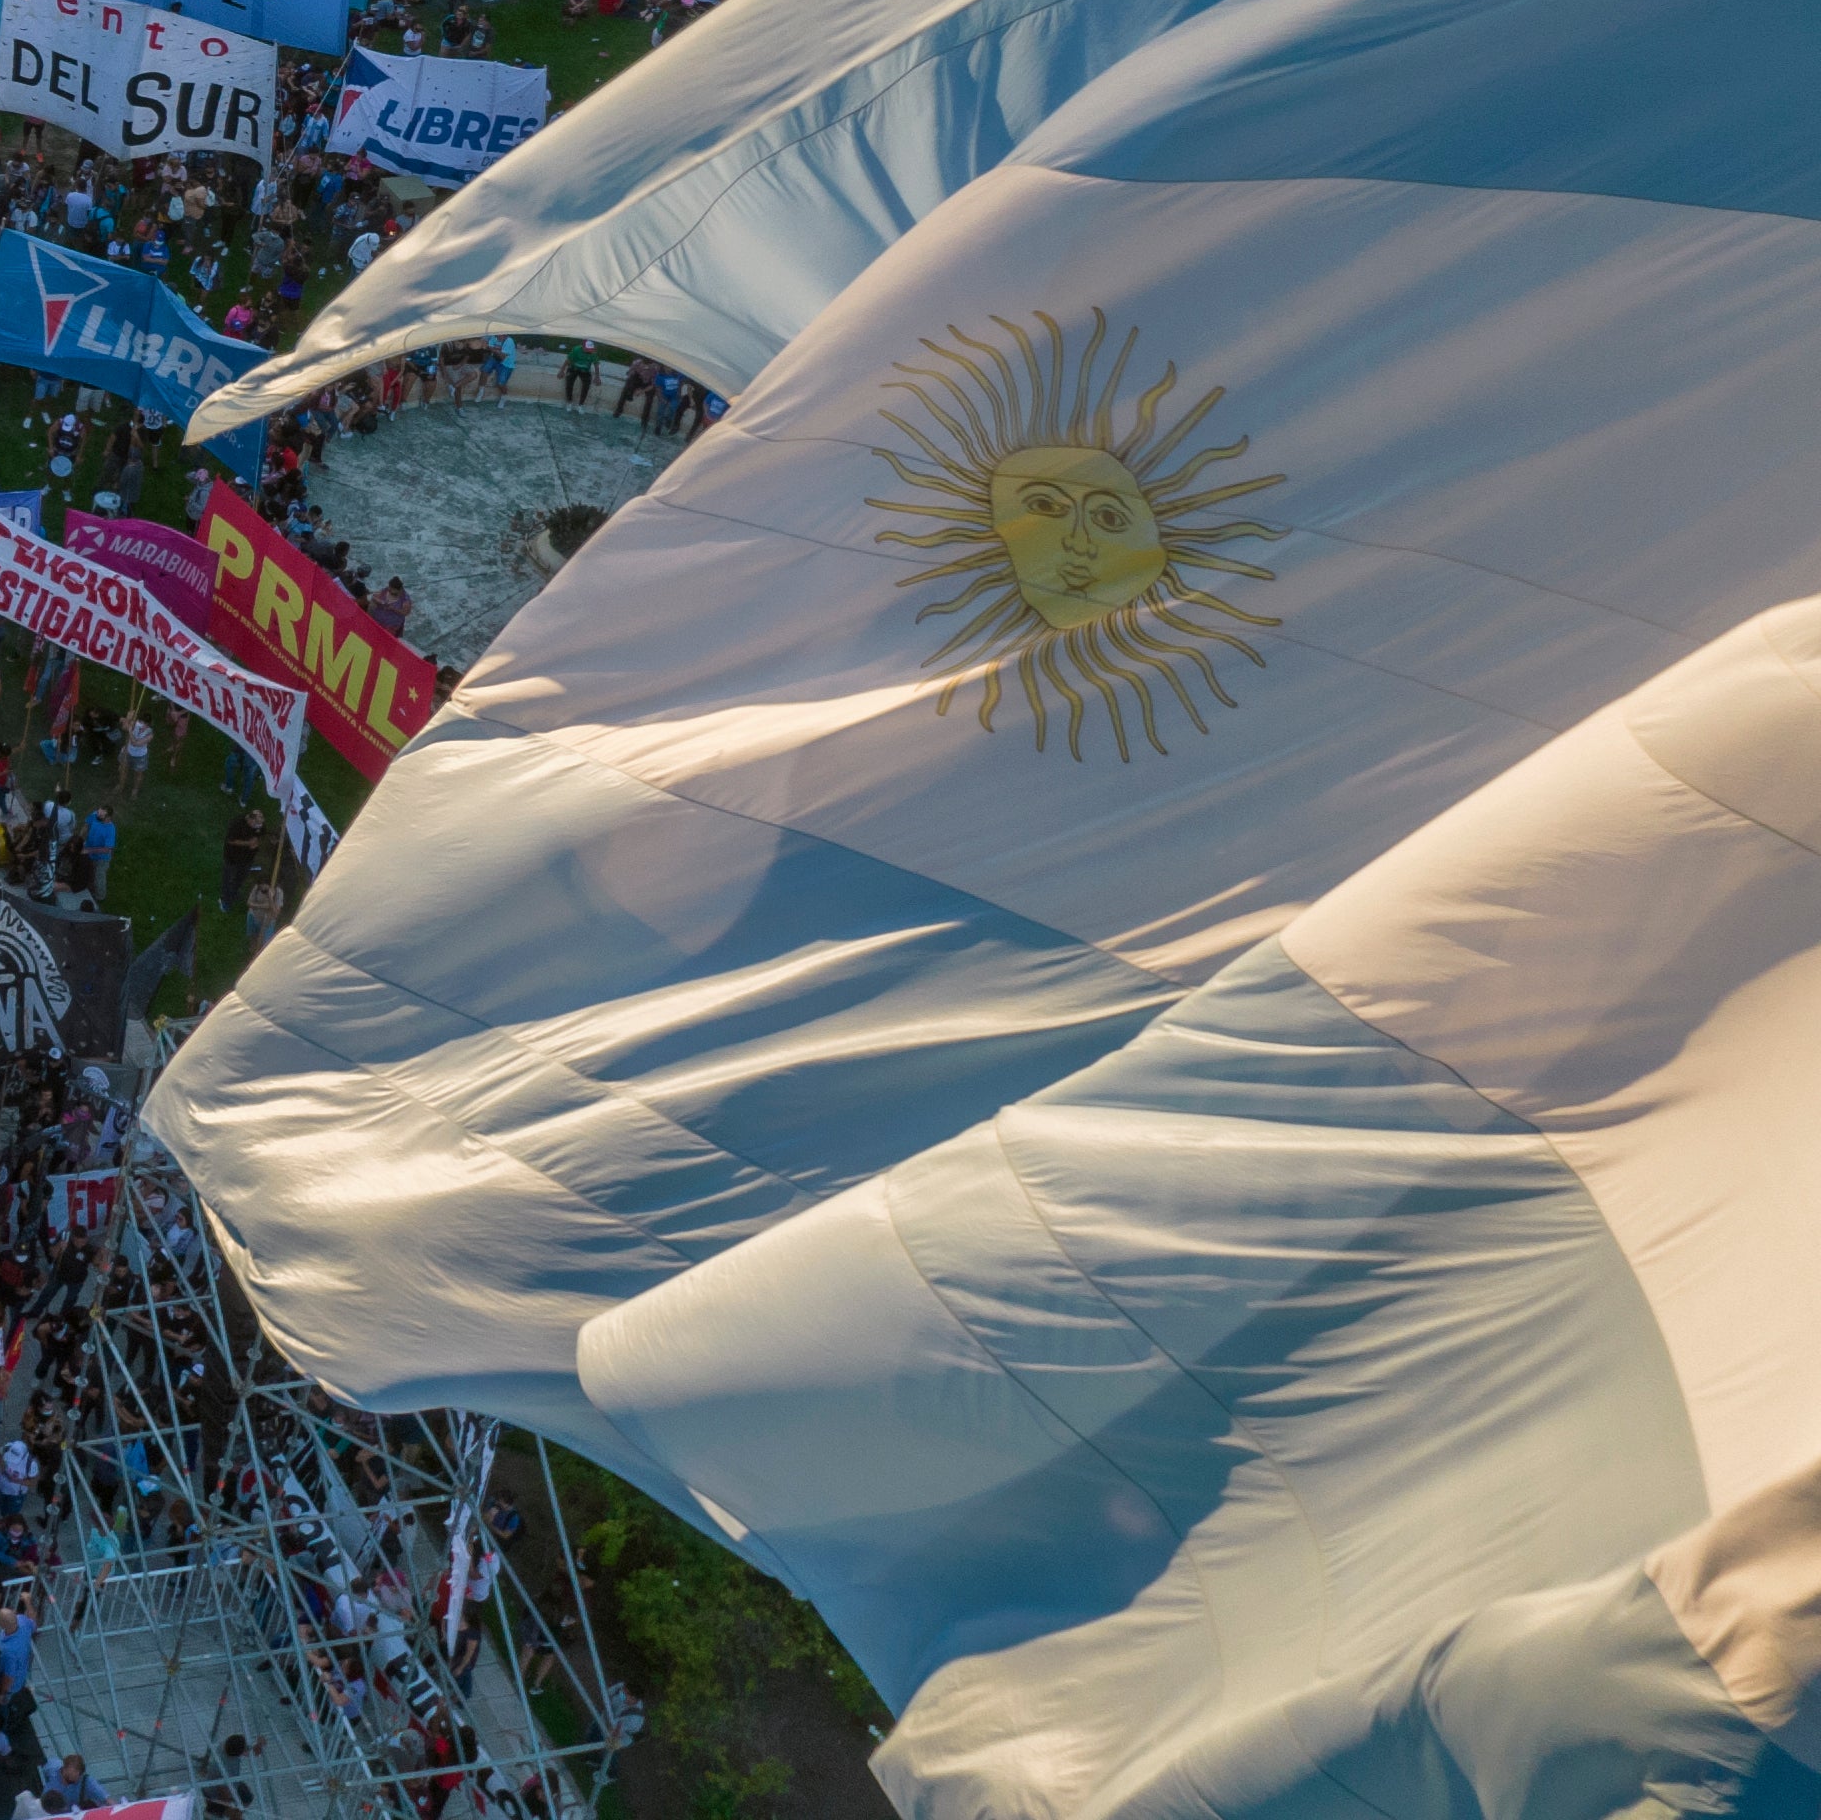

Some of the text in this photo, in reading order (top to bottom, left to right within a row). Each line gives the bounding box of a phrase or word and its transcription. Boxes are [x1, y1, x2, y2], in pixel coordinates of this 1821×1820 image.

[11, 37, 262, 149] DEL SUR
[374, 95, 539, 156] LIBRES
[105, 532, 211, 599] MARABUNTA
[207, 513, 410, 747] PRML
